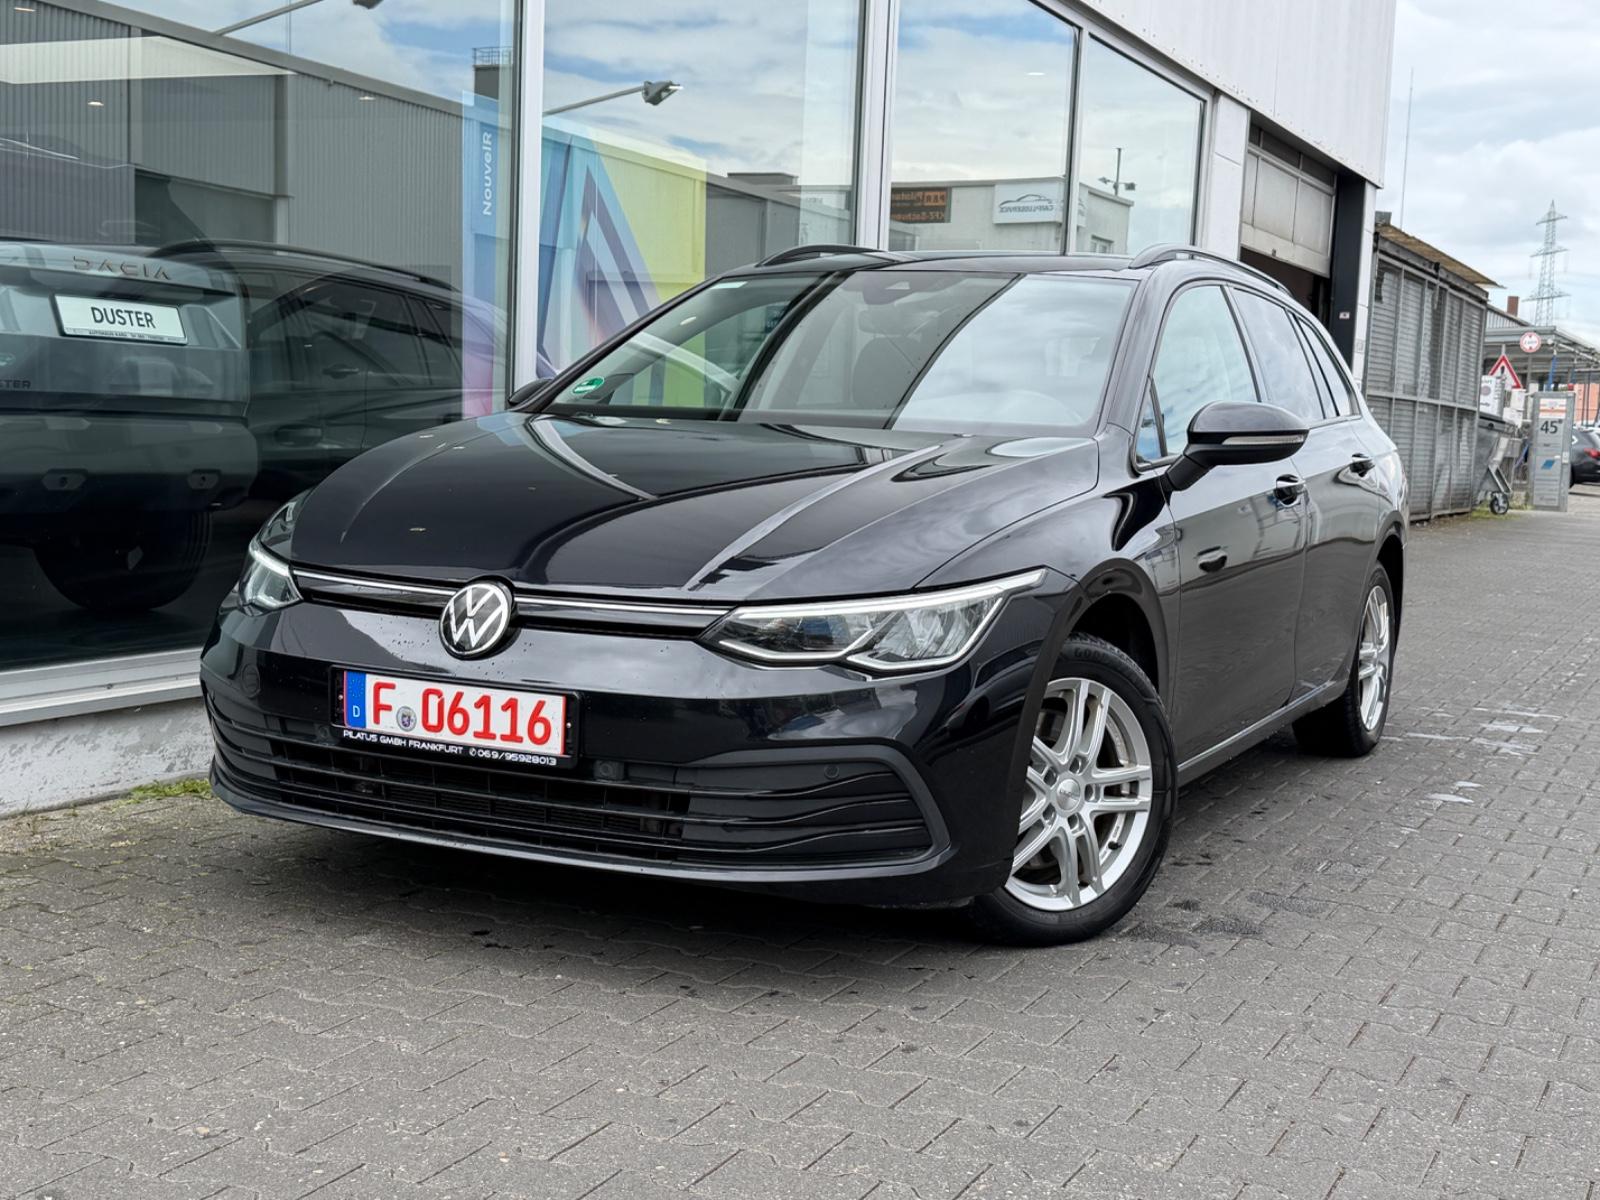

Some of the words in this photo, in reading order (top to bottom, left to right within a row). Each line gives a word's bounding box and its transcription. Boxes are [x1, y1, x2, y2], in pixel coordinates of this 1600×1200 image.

[73, 255, 171, 280] DACIA
[91, 306, 156, 329] DUSTER
[352, 705, 361, 718] D
[373, 681, 396, 725] F
[421, 688, 551, 745] 06116
[343, 730, 378, 743] PILATUS
[408, 740, 464, 755] FRANKFURT
